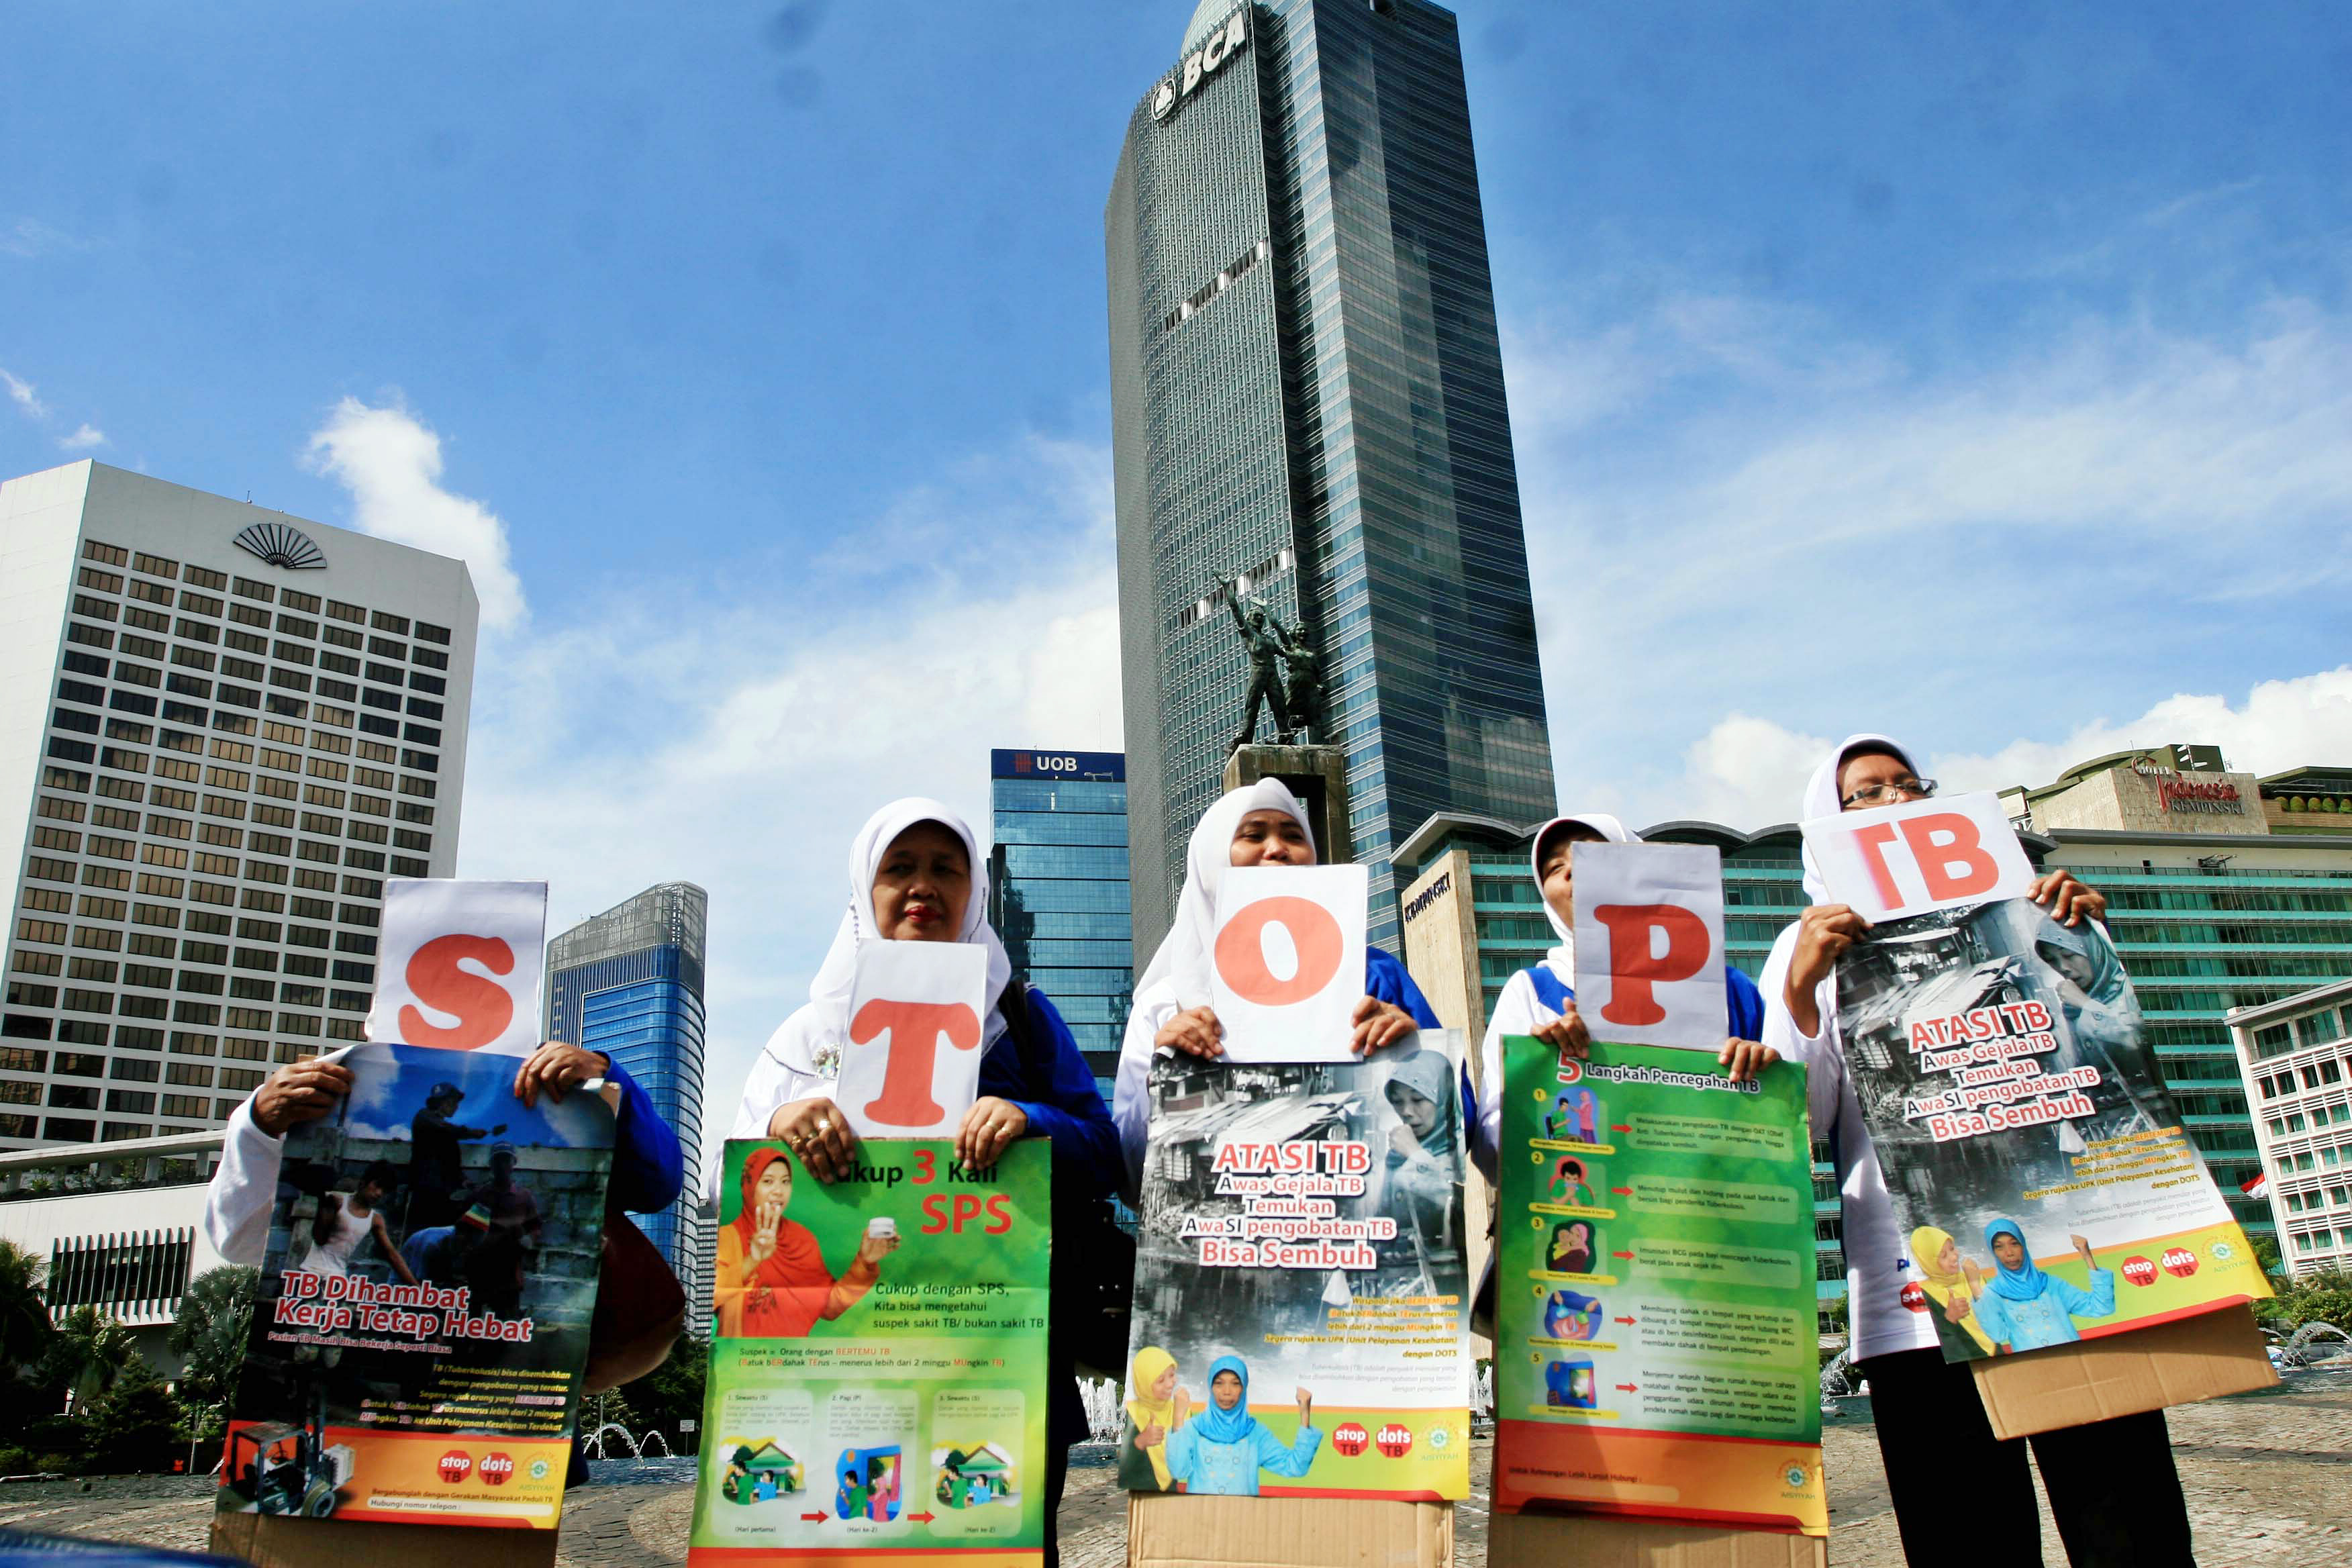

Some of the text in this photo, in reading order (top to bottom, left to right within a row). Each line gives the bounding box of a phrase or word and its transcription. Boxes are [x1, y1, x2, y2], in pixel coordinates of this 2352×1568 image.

[1181, 10, 1246, 97] BCA
[1036, 756, 1077, 771] UOB
[2155, 770, 2240, 813] Indonesia
[2169, 800, 2245, 815] KEMPINSKI
[1832, 812, 2000, 911] TB
[1404, 872, 1451, 924] KEMPINSKI
[1214, 895, 1344, 1006] O
[1593, 903, 1710, 1026] P
[398, 933, 515, 1051] S
[1910, 1002, 2049, 1049] ATASI TB
[1924, 1034, 2053, 1069] Awas Gejala TB
[849, 997, 981, 1127] T
[1558, 1052, 1581, 1082] 5
[1587, 1063, 1650, 1081] Langkah
[1652, 1070, 1739, 1089] Pencegahan
[1955, 1060, 2037, 1085] Temukan
[1908, 1069, 2098, 1114] AwaSI pengobatan TB
[1931, 1093, 2092, 1139] Bisa Sembuh
[2086, 1136, 2135, 1149] Waspada jika
[1215, 1142, 1368, 1171] ATASI TB
[1534, 1153, 1540, 1162] 2
[2073, 1155, 2094, 1166] Batuk
[2153, 1140, 2186, 1150] menerus
[911, 1149, 936, 1185] 3
[2075, 1169, 2094, 1177] lebih
[2094, 1165, 2109, 1174] dari
[2116, 1161, 2143, 1172] minggu
[2144, 1155, 2177, 1167] MUngkin
[1219, 1177, 1363, 1195] Awas Gejala TB
[2023, 1190, 2049, 1200] Segera
[2051, 1186, 2069, 1196] rujuk
[2081, 1181, 2095, 1189] UPK
[2096, 1177, 2114, 1188] (Unit
[2116, 1170, 2154, 1184] Pelayanan
[2155, 1163, 2195, 1177] Kesehatan)
[2151, 1175, 2200, 1189] dengan DOTS
[1244, 1197, 1333, 1214] Temukan
[920, 1194, 1012, 1234] SPS
[1185, 1218, 1394, 1238] AwaSI pengobatan TB
[1534, 1219, 1540, 1228] 3
[1202, 1239, 1374, 1266] Bisa Sembuh
[2161, 1251, 2195, 1267] dots
[2123, 1261, 2153, 1275] stop
[2173, 1265, 2194, 1277] TB
[2135, 1275, 2154, 1286] TB
[283, 1271, 469, 1310] TB Dihambat
[875, 1283, 1010, 1297] Cukup dengan SPS,
[1535, 1287, 1542, 1295] 4
[874, 1302, 987, 1313] Kita bisa mengetahui
[275, 1297, 535, 1342] Kerja Tetap Hebat
[873, 1318, 1044, 1330] suspek sakit TB/ bukan sakit TB
[1349, 1323, 1366, 1331] dari
[1373, 1324, 1405, 1333] minggu
[268, 1332, 297, 1342] Pasien
[311, 1335, 338, 1345] Masih
[360, 1338, 393, 1351] Bekerja
[1265, 1335, 1293, 1344] Segera
[1294, 1335, 1314, 1344] rujuk
[1368, 1336, 1410, 1345] Pelayanan
[1412, 1336, 1457, 1344] Kesehatan)
[740, 1348, 891, 1357] Suspek Orang dengan BERTEMU TB
[1402, 1351, 1433, 1359] dengan
[1533, 1353, 1540, 1362] 5
[875, 1359, 895, 1367] lebih
[897, 1359, 912, 1367] dari
[922, 1359, 951, 1369] minggu
[953, 1359, 989, 1369] MUngkin
[528, 1408, 534, 1417] 2
[442, 1418, 485, 1429] Pelayanan
[1335, 1428, 1367, 1443] stop
[1377, 1426, 1412, 1443] dots
[1341, 1444, 1359, 1456] TB
[1384, 1445, 1404, 1457] TB
[441, 1456, 471, 1470] stop
[481, 1456, 513, 1471] dots
[444, 1471, 461, 1483] TB
[485, 1473, 502, 1485] TB
[423, 1491, 450, 1500] dengan
[451, 1492, 482, 1500] Gerakan
[483, 1493, 521, 1503] Masyarakat
[371, 1500, 457, 1512] Hubungi nomor telepon
